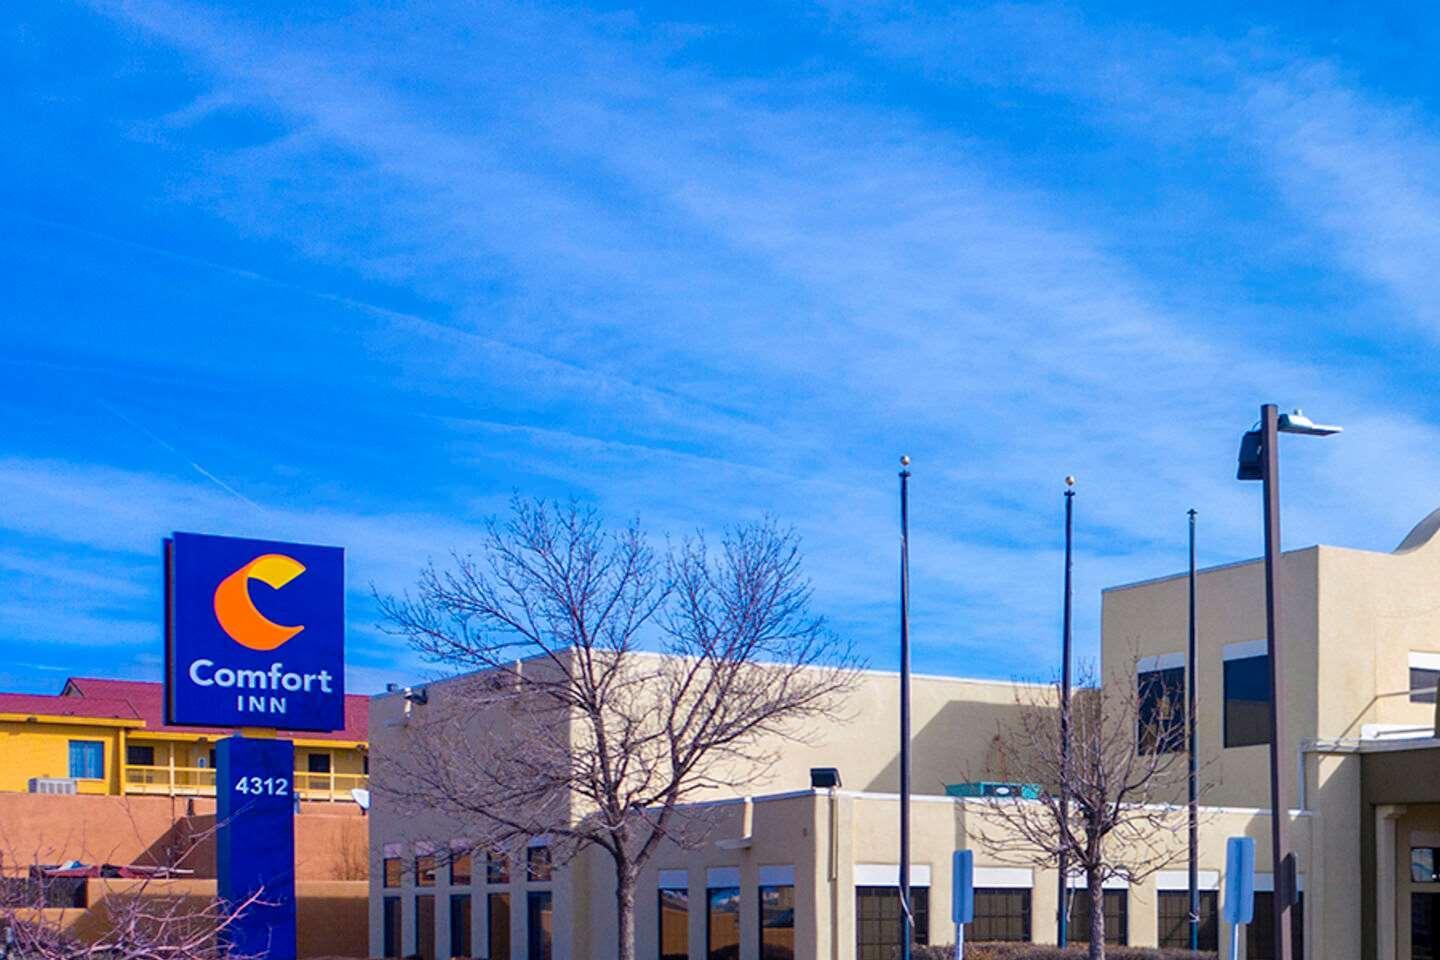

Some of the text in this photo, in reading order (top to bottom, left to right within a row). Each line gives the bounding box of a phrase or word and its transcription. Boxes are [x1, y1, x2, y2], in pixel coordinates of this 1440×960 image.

[189, 659, 333, 693] Comfort
[237, 696, 287, 714] INN
[235, 776, 289, 796] 4312
